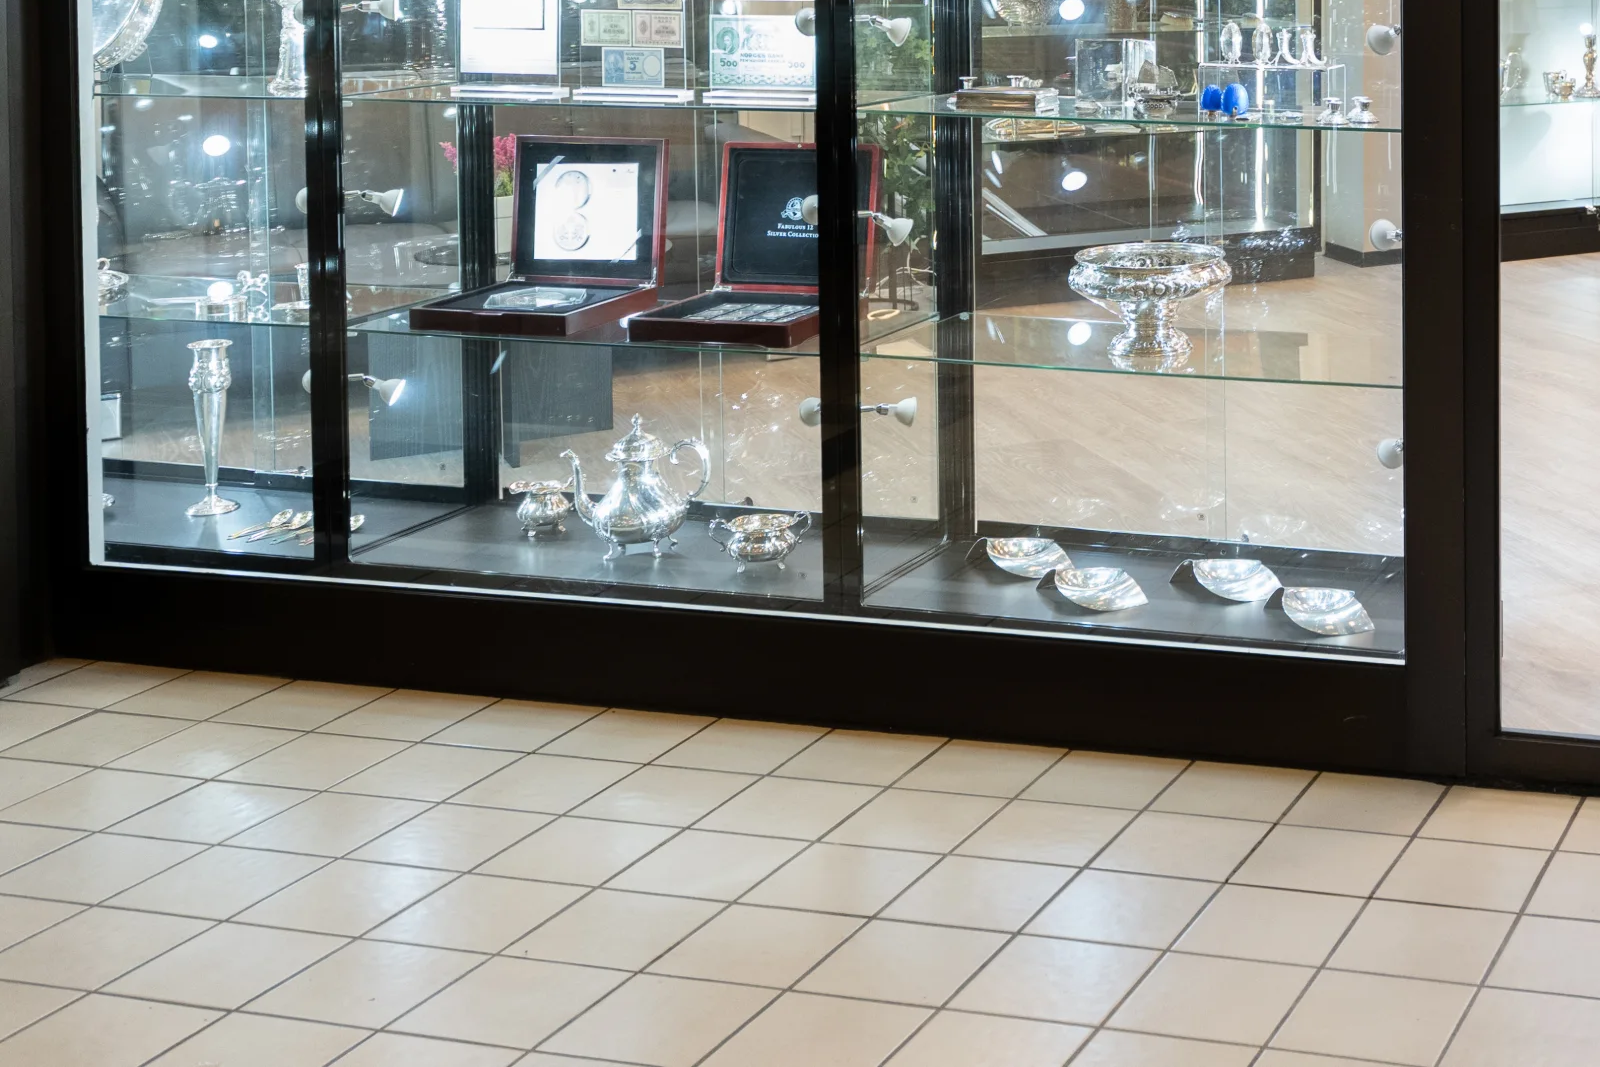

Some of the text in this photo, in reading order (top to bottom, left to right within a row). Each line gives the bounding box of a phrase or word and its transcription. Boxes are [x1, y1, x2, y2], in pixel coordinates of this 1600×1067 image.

[629, 60, 639, 71] 5
[720, 58, 738, 67] 500
[787, 231, 820, 239] COLLECTIO
